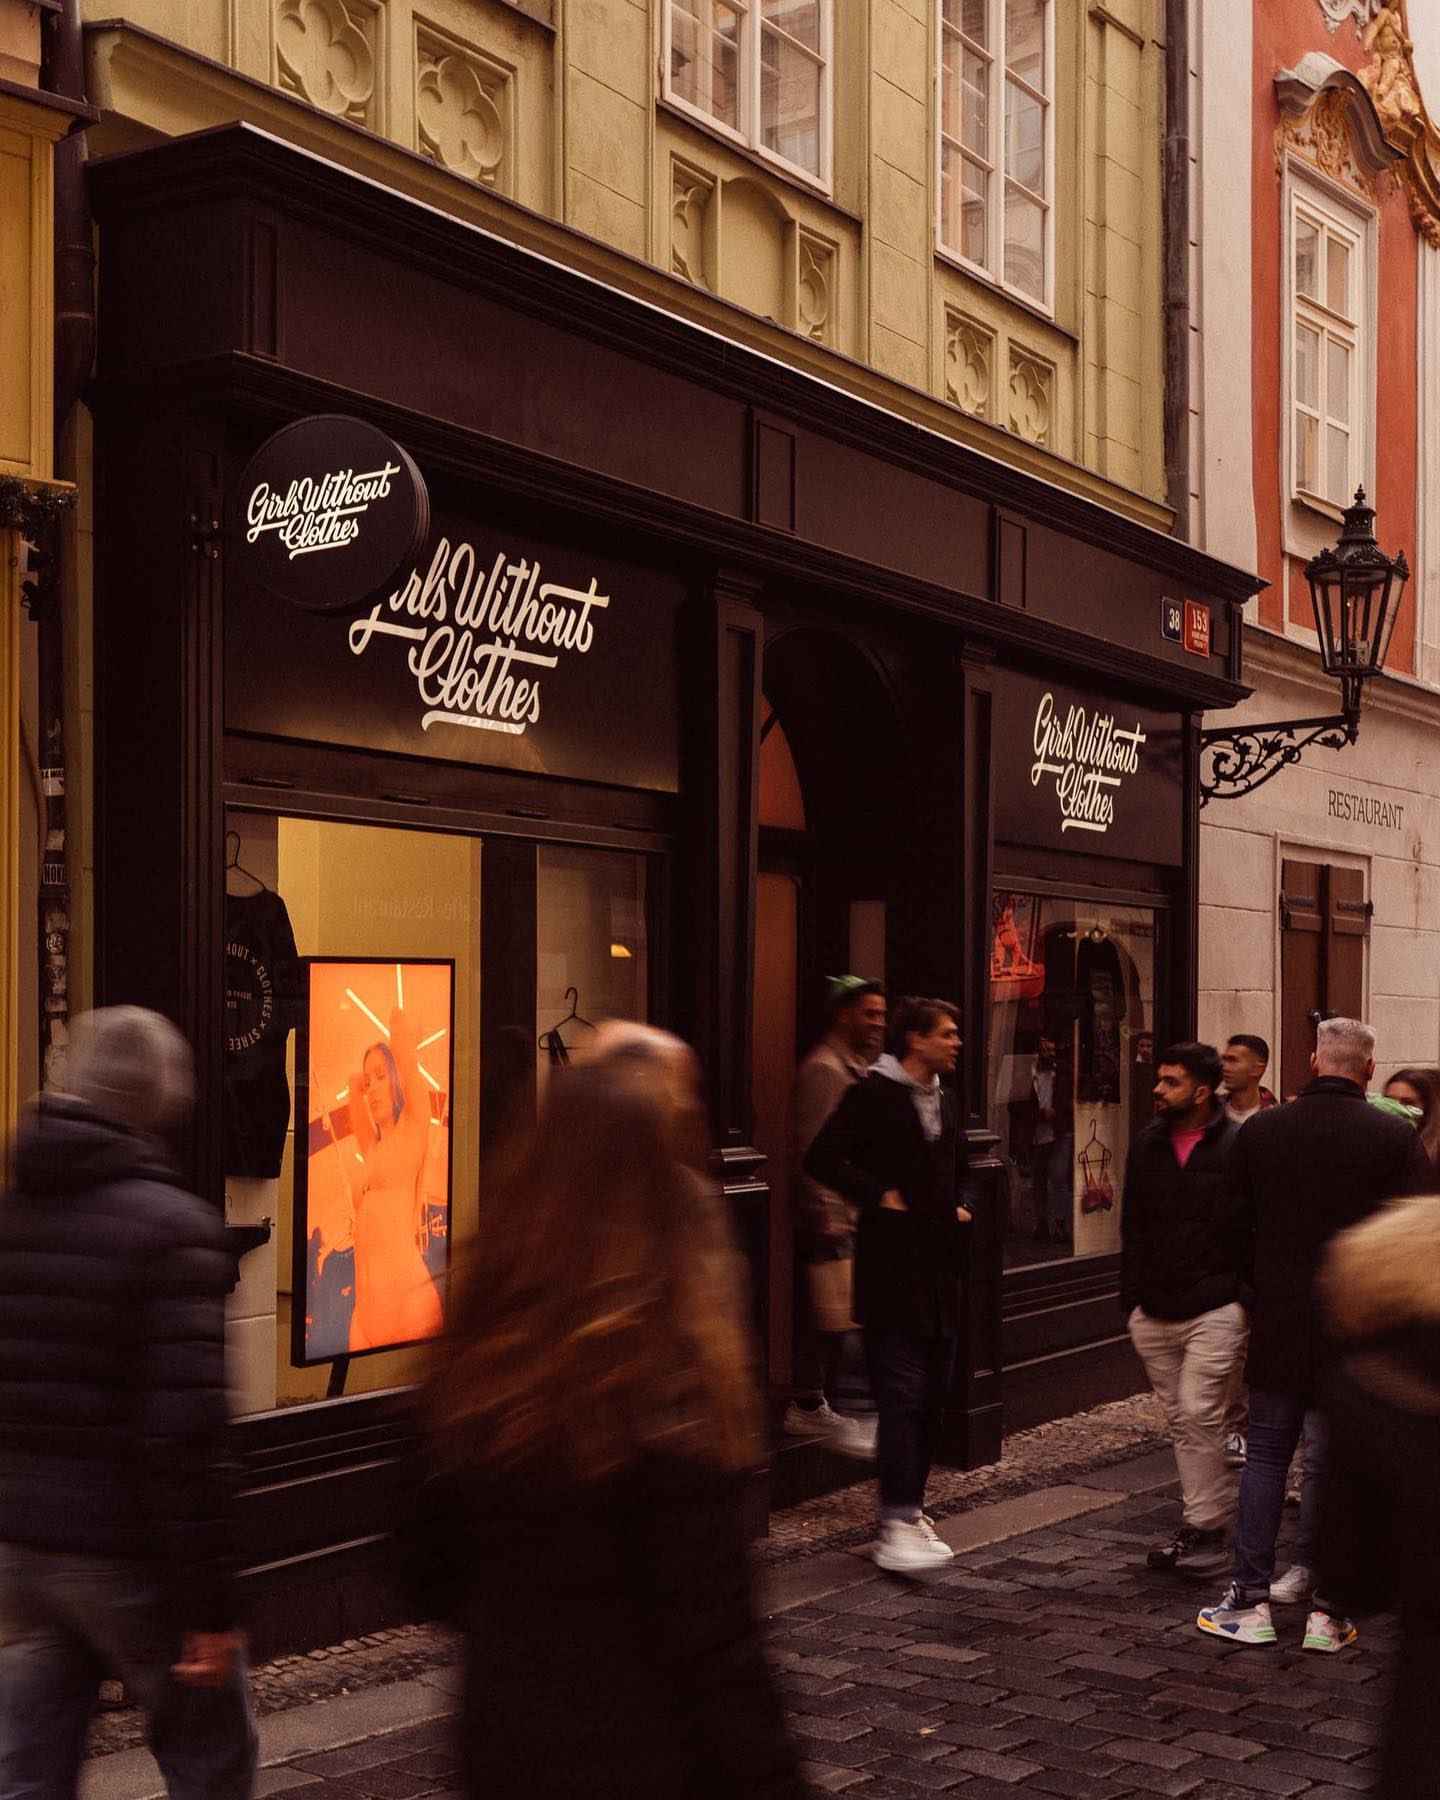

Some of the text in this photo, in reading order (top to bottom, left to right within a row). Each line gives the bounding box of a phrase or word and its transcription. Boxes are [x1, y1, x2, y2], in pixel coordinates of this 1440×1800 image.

[246, 461, 400, 545] Girls Without
[279, 503, 368, 560] Clothes
[448, 541, 610, 655] Without
[1168, 607, 1181, 632] 38
[407, 626, 559, 736] Clothes
[1031, 691, 1147, 787] Girls Without
[1055, 763, 1122, 833] Clothes
[1327, 789, 1404, 831] RESTAURANT
[256, 965, 273, 1020] CLOTHES
